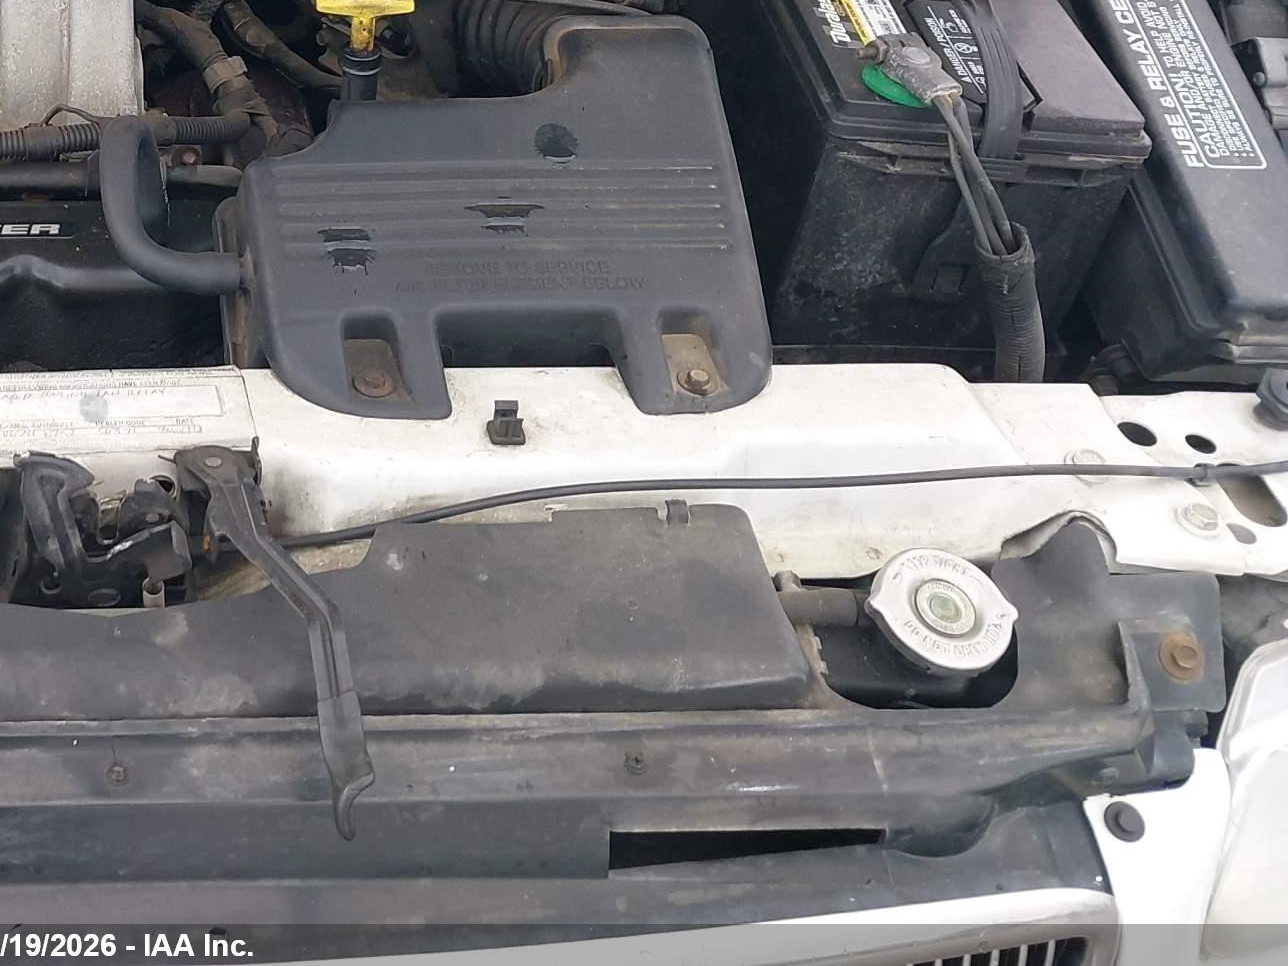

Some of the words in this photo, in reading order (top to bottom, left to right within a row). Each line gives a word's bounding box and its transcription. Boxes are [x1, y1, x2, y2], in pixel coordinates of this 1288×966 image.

[1135, 2, 1156, 26] AVOID
[1149, 10, 1167, 28] NOT
[1159, 7, 1182, 40] SERVICING
[924, 17, 946, 42] POISON
[1172, 19, 1186, 35] ONLY
[1150, 30, 1169, 52] HELP
[1160, 32, 1186, 66] ENGINE
[1182, 39, 1200, 62] RELAYS
[943, 47, 967, 75] DANGER
[1123, 29, 1167, 89] RELAY
[1163, 56, 1176, 66] TO
[1177, 43, 1196, 69] BEFORE
[1190, 41, 1214, 74] PROPERLY
[1179, 70, 1208, 109] AND/OR
[1192, 72, 1212, 102] BATTERY
[1200, 74, 1217, 95] FUSES
[1209, 78, 1219, 86] TO
[1158, 96, 1175, 107] &
[1214, 89, 1230, 107] SURE
[1168, 73, 1221, 157] CAUTION!
[1208, 105, 1237, 150] DISCONNECT
[1212, 98, 1235, 133] SPECIFIED
[1164, 113, 1205, 167] FUSE
[1201, 113, 1231, 155] DAMAGE
[1230, 136, 1244, 150] USE
[1231, 122, 1252, 150] ALWAYS
[424, 261, 501, 275] REMOVE
[507, 261, 529, 274] TO
[535, 260, 611, 274] SERVICE
[583, 275, 648, 291] BELOW
